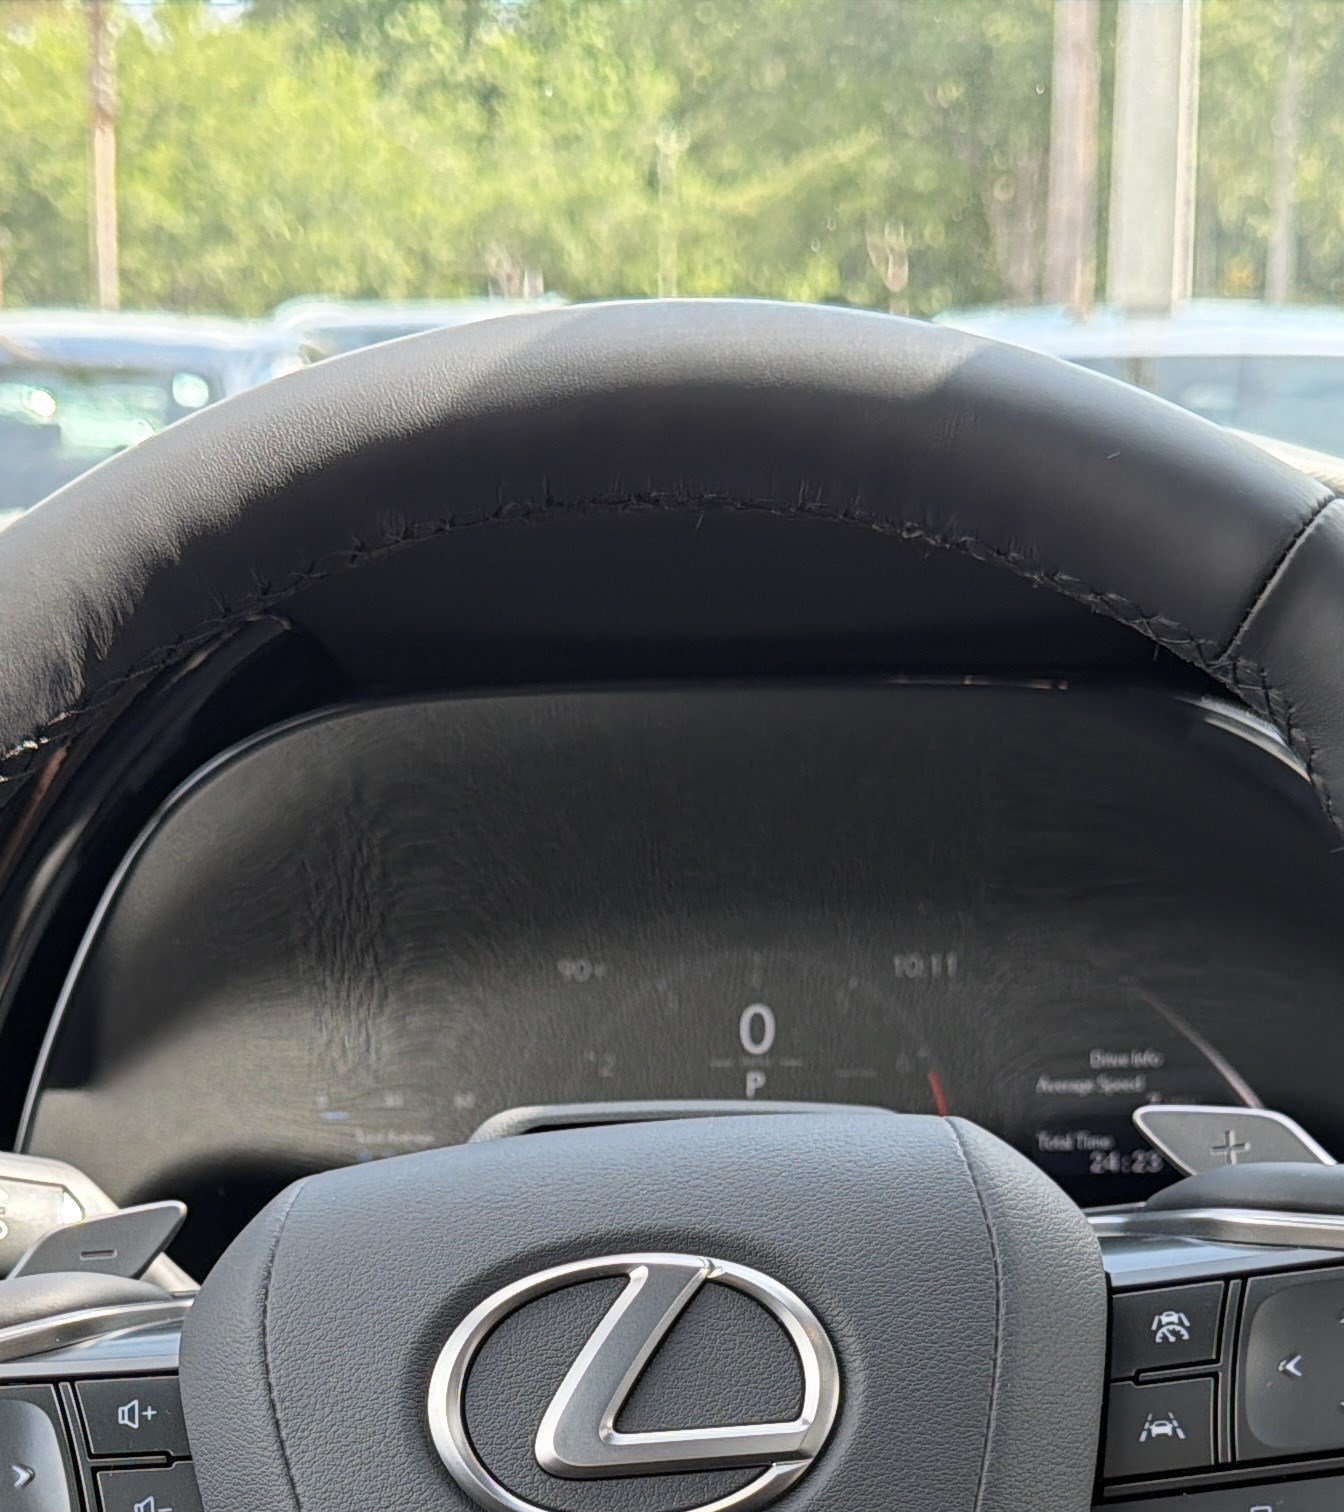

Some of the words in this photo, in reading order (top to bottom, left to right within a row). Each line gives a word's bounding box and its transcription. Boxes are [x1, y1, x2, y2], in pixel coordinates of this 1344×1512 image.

[739, 1003, 776, 1055] 0
[1089, 1049, 1130, 1070] Drive
[746, 1070, 766, 1099] P
[1035, 1074, 1094, 1096] Average
[1096, 1073, 1146, 1095] Speed
[1036, 1131, 1074, 1151] Total
[1076, 1131, 1115, 1151] Time
